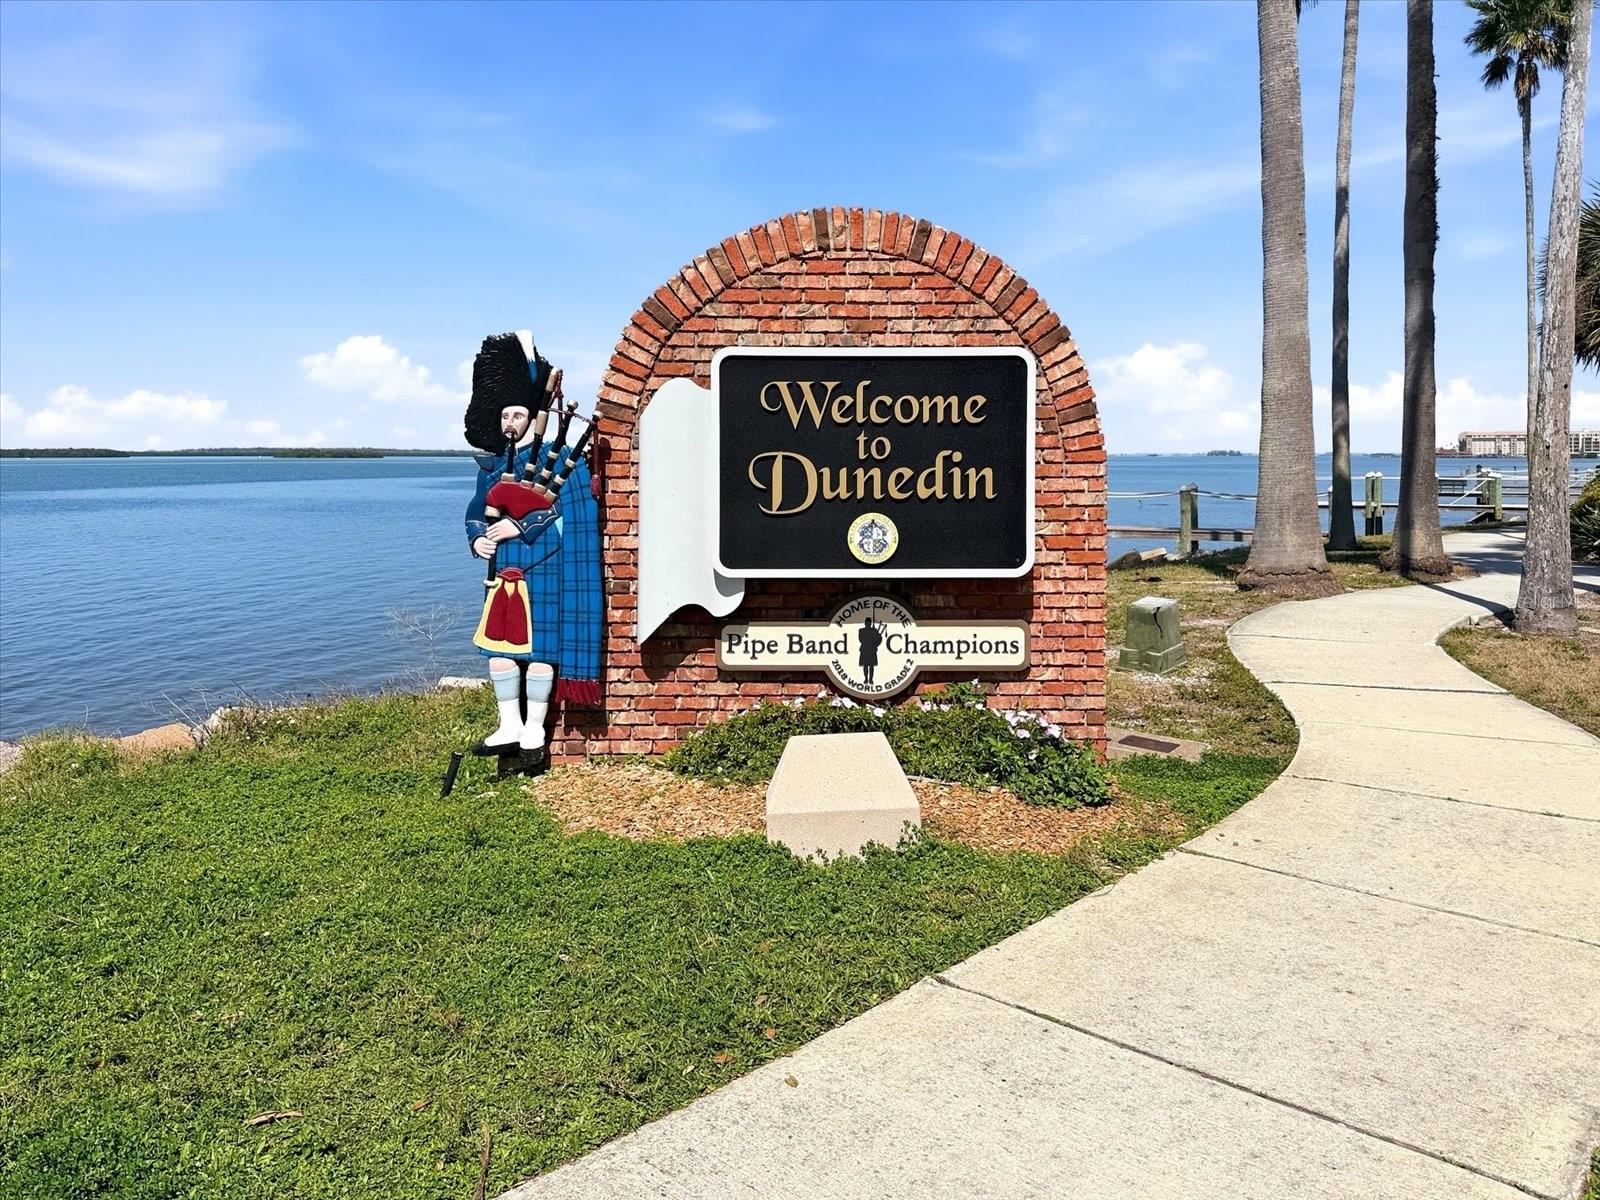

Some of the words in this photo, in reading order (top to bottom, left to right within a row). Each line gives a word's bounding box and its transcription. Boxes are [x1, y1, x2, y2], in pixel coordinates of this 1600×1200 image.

[760, 380, 988, 430] Welcome
[855, 430, 892, 460] to
[748, 450, 998, 515] Dunedin
[835, 600, 871, 628] HOME
[873, 599, 891, 610] OF
[892, 605, 912, 628] THE
[725, 633, 779, 660] Pipe
[786, 633, 849, 655] Band
[886, 633, 1020, 660] Champions
[832, 659, 848, 680] 2018
[848, 678, 883, 693] WORLD
[884, 666, 910, 690] GRADE
[906, 658, 914, 667] 2
